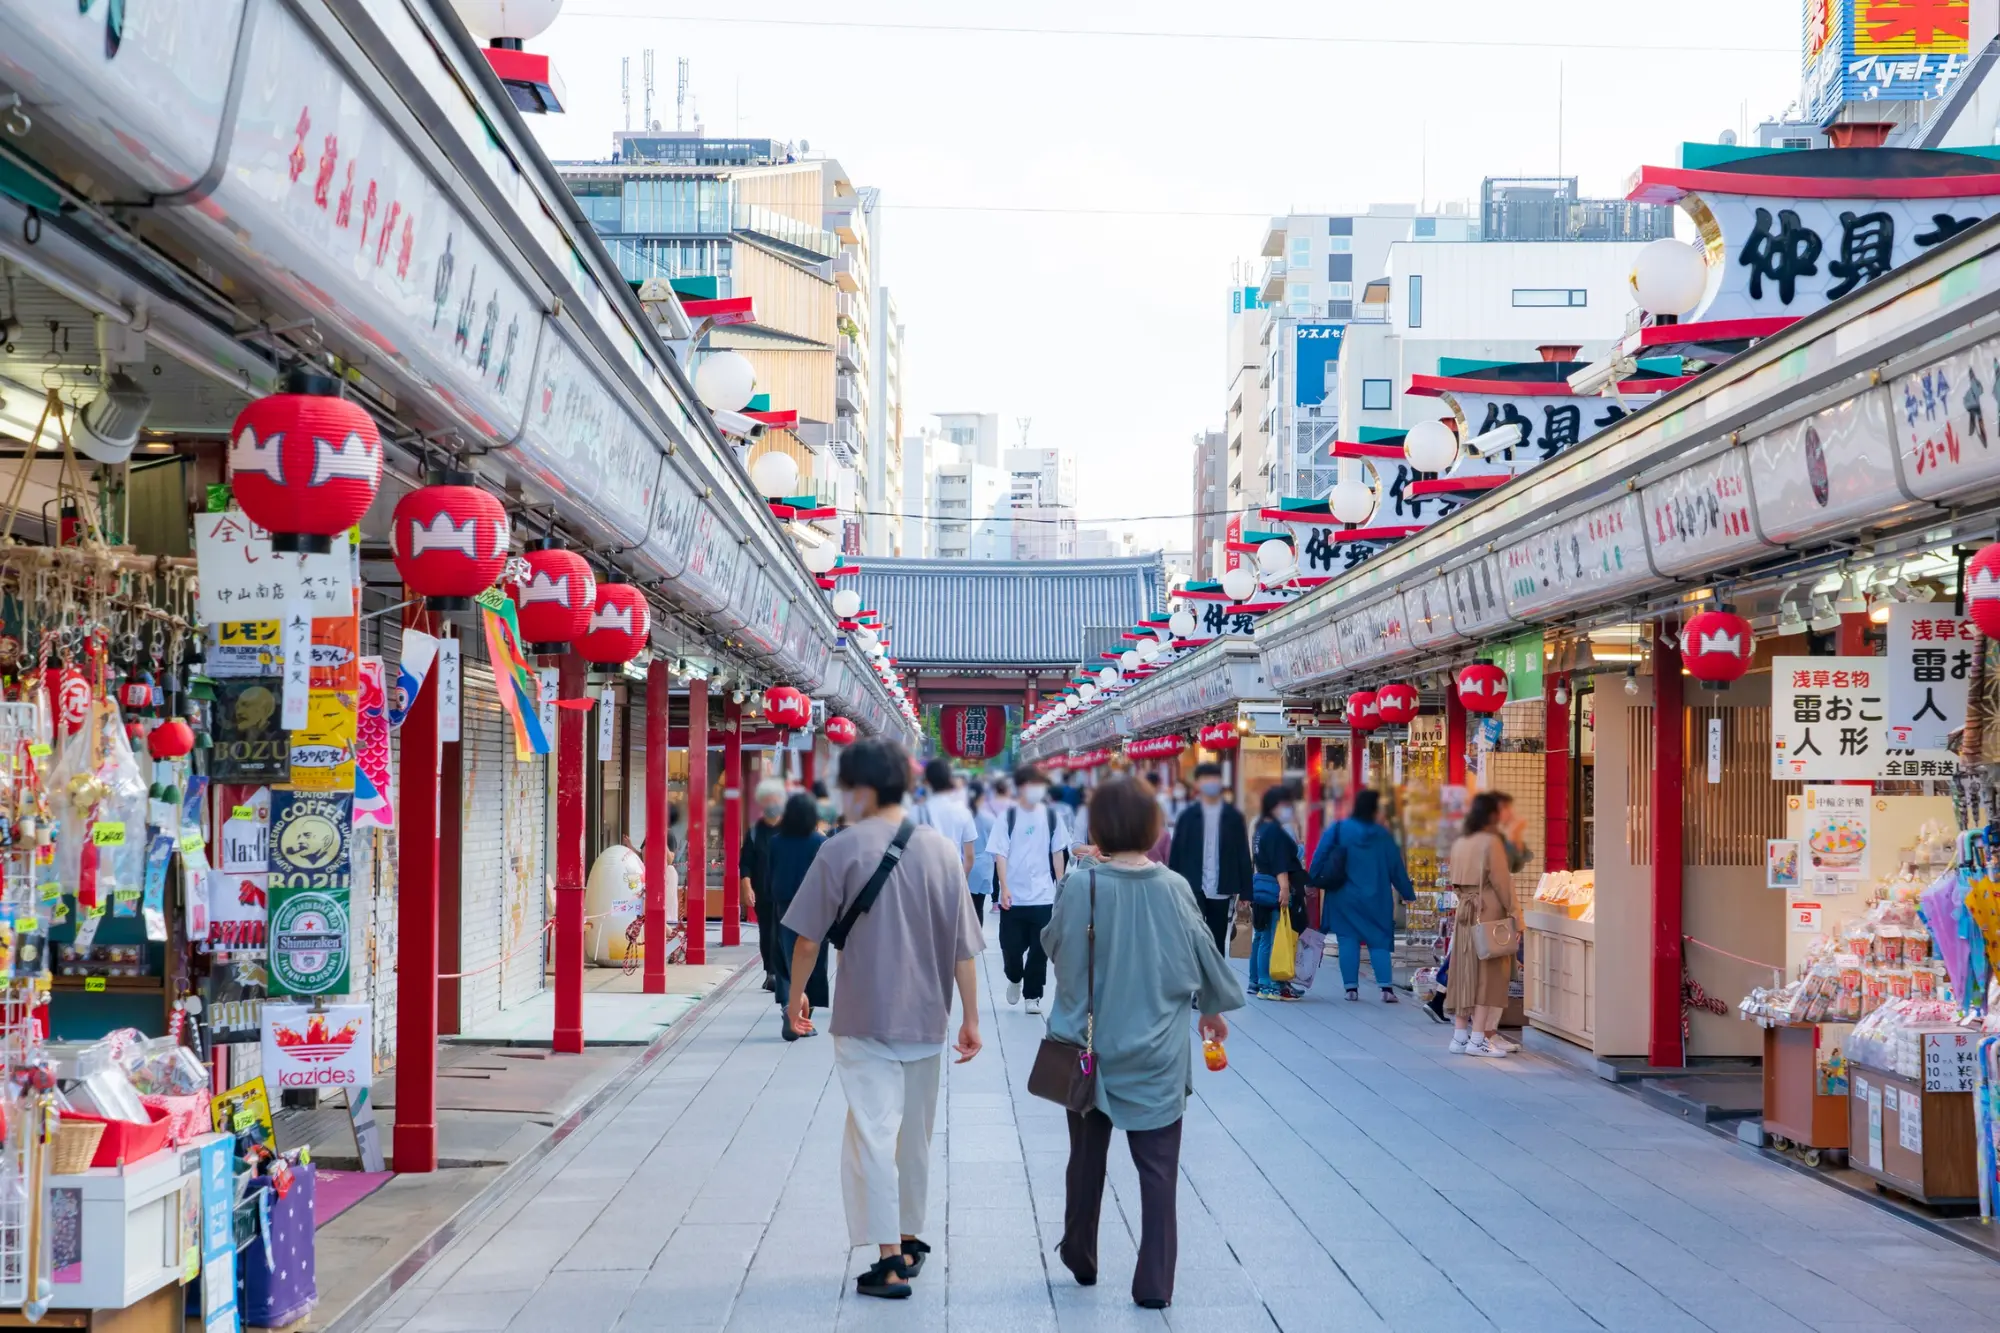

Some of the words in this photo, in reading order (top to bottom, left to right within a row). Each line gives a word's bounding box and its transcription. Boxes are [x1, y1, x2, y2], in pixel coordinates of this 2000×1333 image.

[222, 622, 277, 641] レモン
[1792, 670, 1870, 689] 浅草名物
[1793, 694, 1883, 723] 雷おこ
[1911, 687, 1948, 722] 人
[213, 739, 290, 761] BOZU
[1792, 727, 1916, 757] 人形
[281, 800, 345, 824] COFFEE
[280, 936, 340, 949] Shimuraken
[281, 959, 306, 982] HENNA
[308, 959, 337, 983] OJISAN
[1926, 1053, 1940, 1064] 10
[278, 1066, 355, 1086] kazides
[1926, 1067, 1940, 1077] 10
[1926, 1080, 1941, 1091] 20
